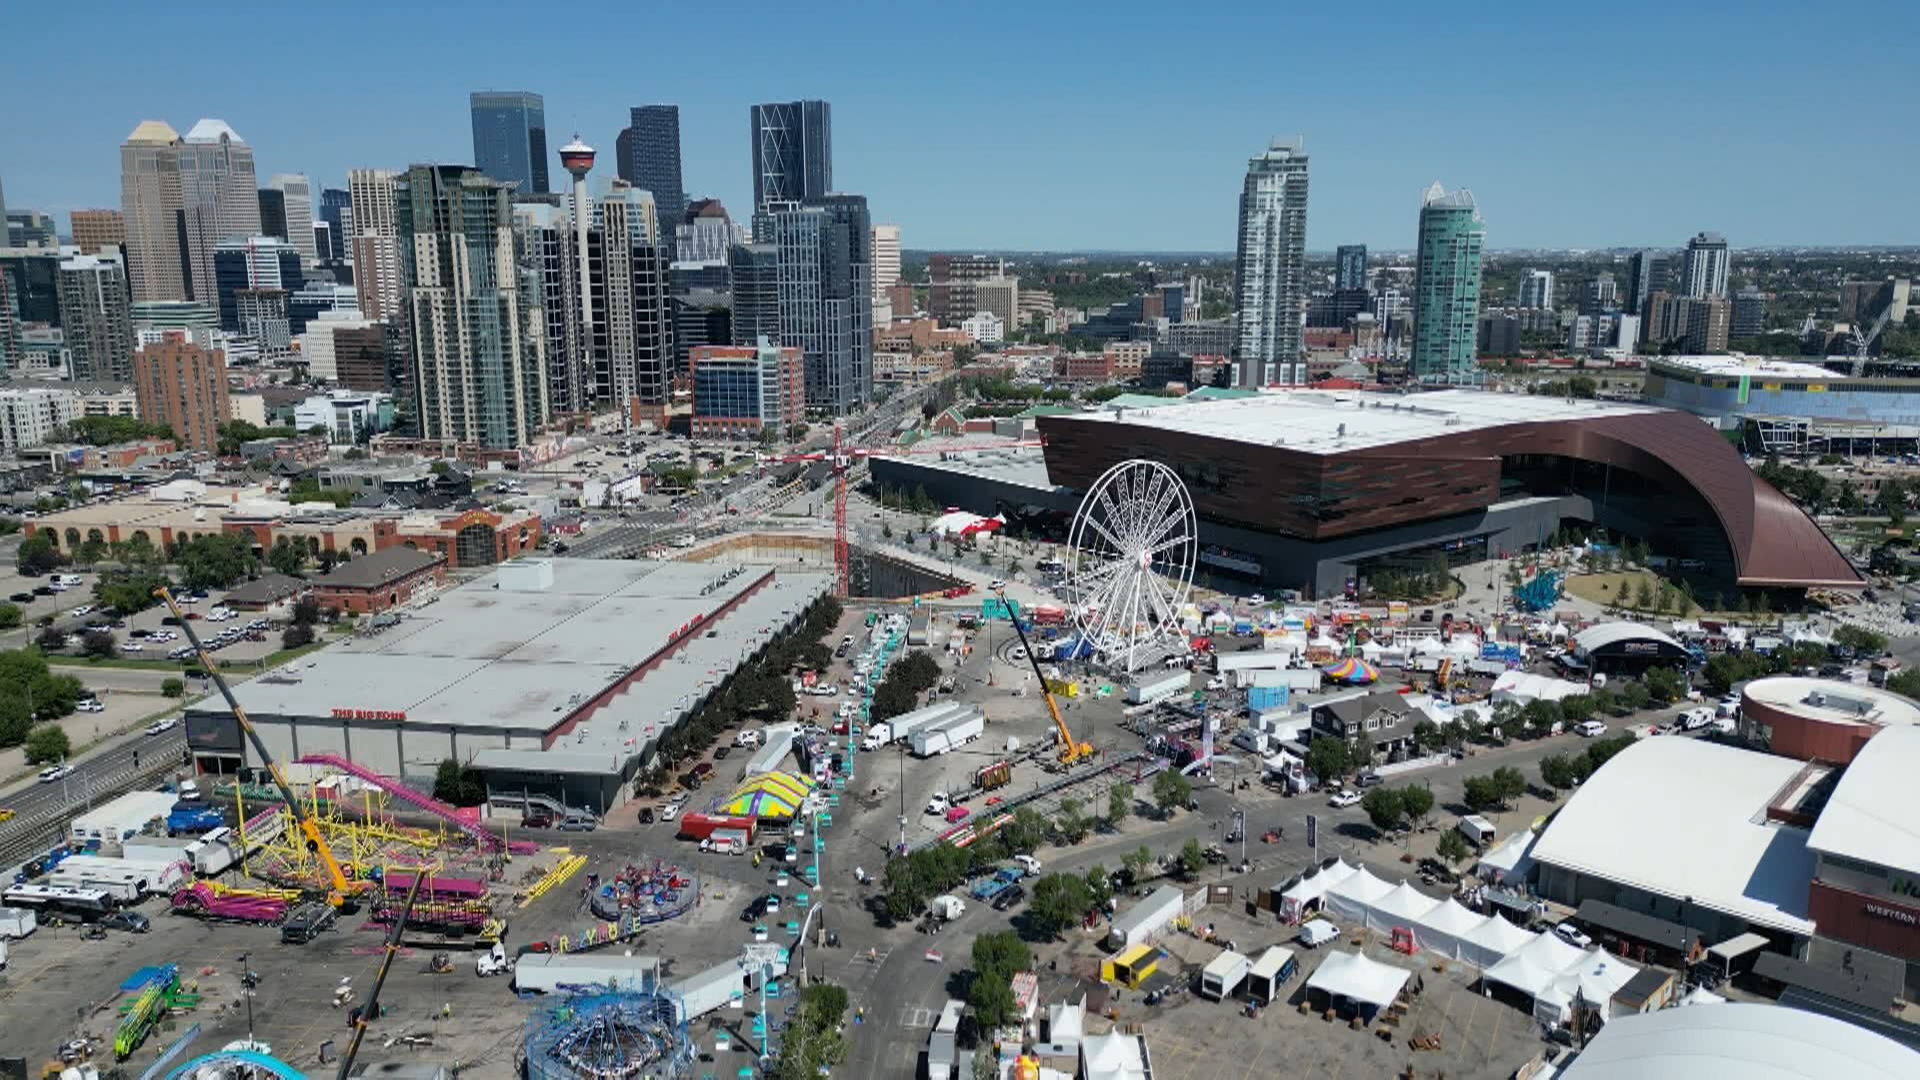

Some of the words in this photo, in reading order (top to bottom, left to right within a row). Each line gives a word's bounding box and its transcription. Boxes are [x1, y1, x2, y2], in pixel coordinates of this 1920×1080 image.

[331, 708, 353, 719] THE
[356, 709, 374, 720] BIG
[1866, 903, 1916, 924] WESTERN
